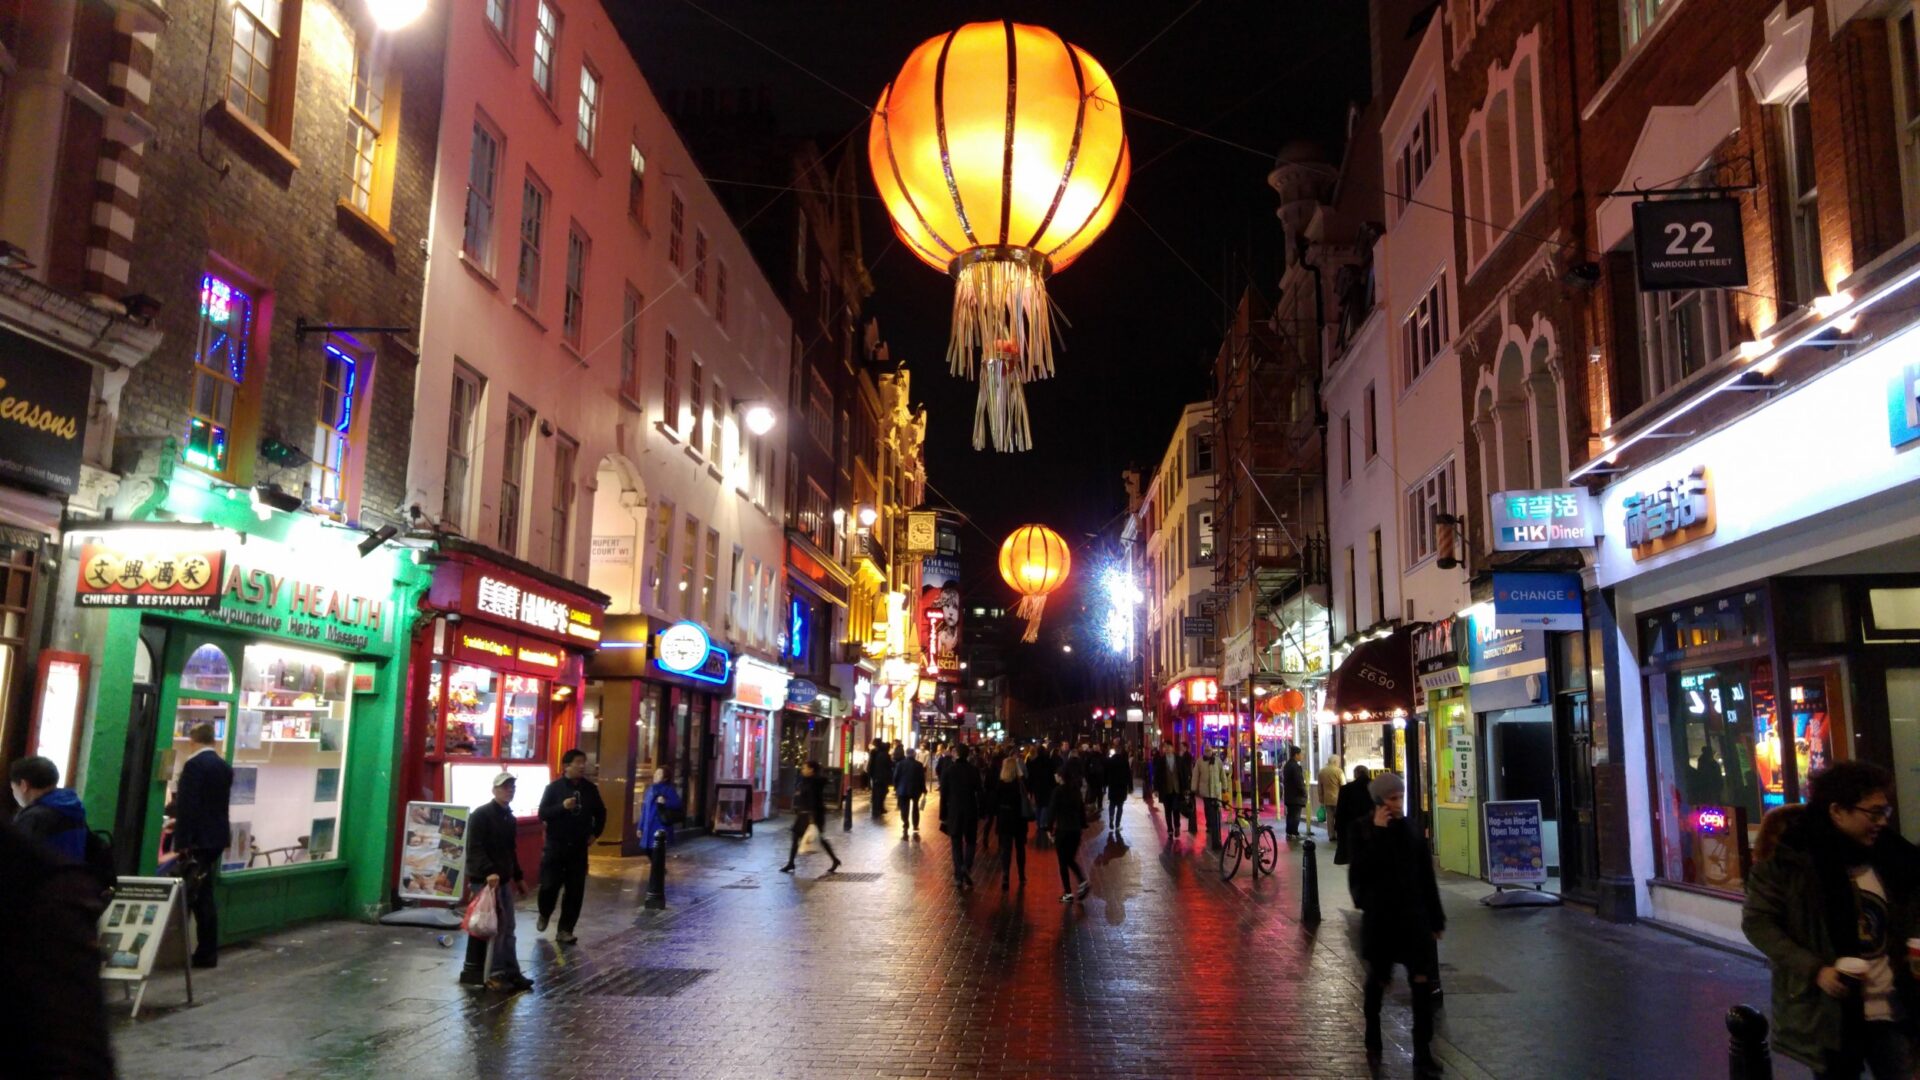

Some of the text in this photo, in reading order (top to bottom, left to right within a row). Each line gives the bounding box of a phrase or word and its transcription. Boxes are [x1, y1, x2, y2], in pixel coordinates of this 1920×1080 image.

[1664, 222, 1715, 255] 22
[1652, 257, 1732, 269] WARDOUR STREET
[47, 470, 72, 486] branch
[1514, 525, 1584, 541] HK Diner
[592, 539, 619, 547] RUPERT
[592, 547, 629, 555] COURT W1
[926, 559, 942, 567] THE
[82, 594, 211, 606] CHINESE RESTAURANT
[223, 564, 382, 631] ASY HEALTH
[1510, 590, 1564, 601] CHANGE
[942, 644, 954, 658] Les
[1357, 667, 1395, 690] £6.90
[1343, 709, 1408, 720] TAK RIS
[1488, 815, 1538, 826] Hop-on Hop-off
[1699, 812, 1724, 828] OPEN
[1491, 826, 1537, 837] Open Top Tours
